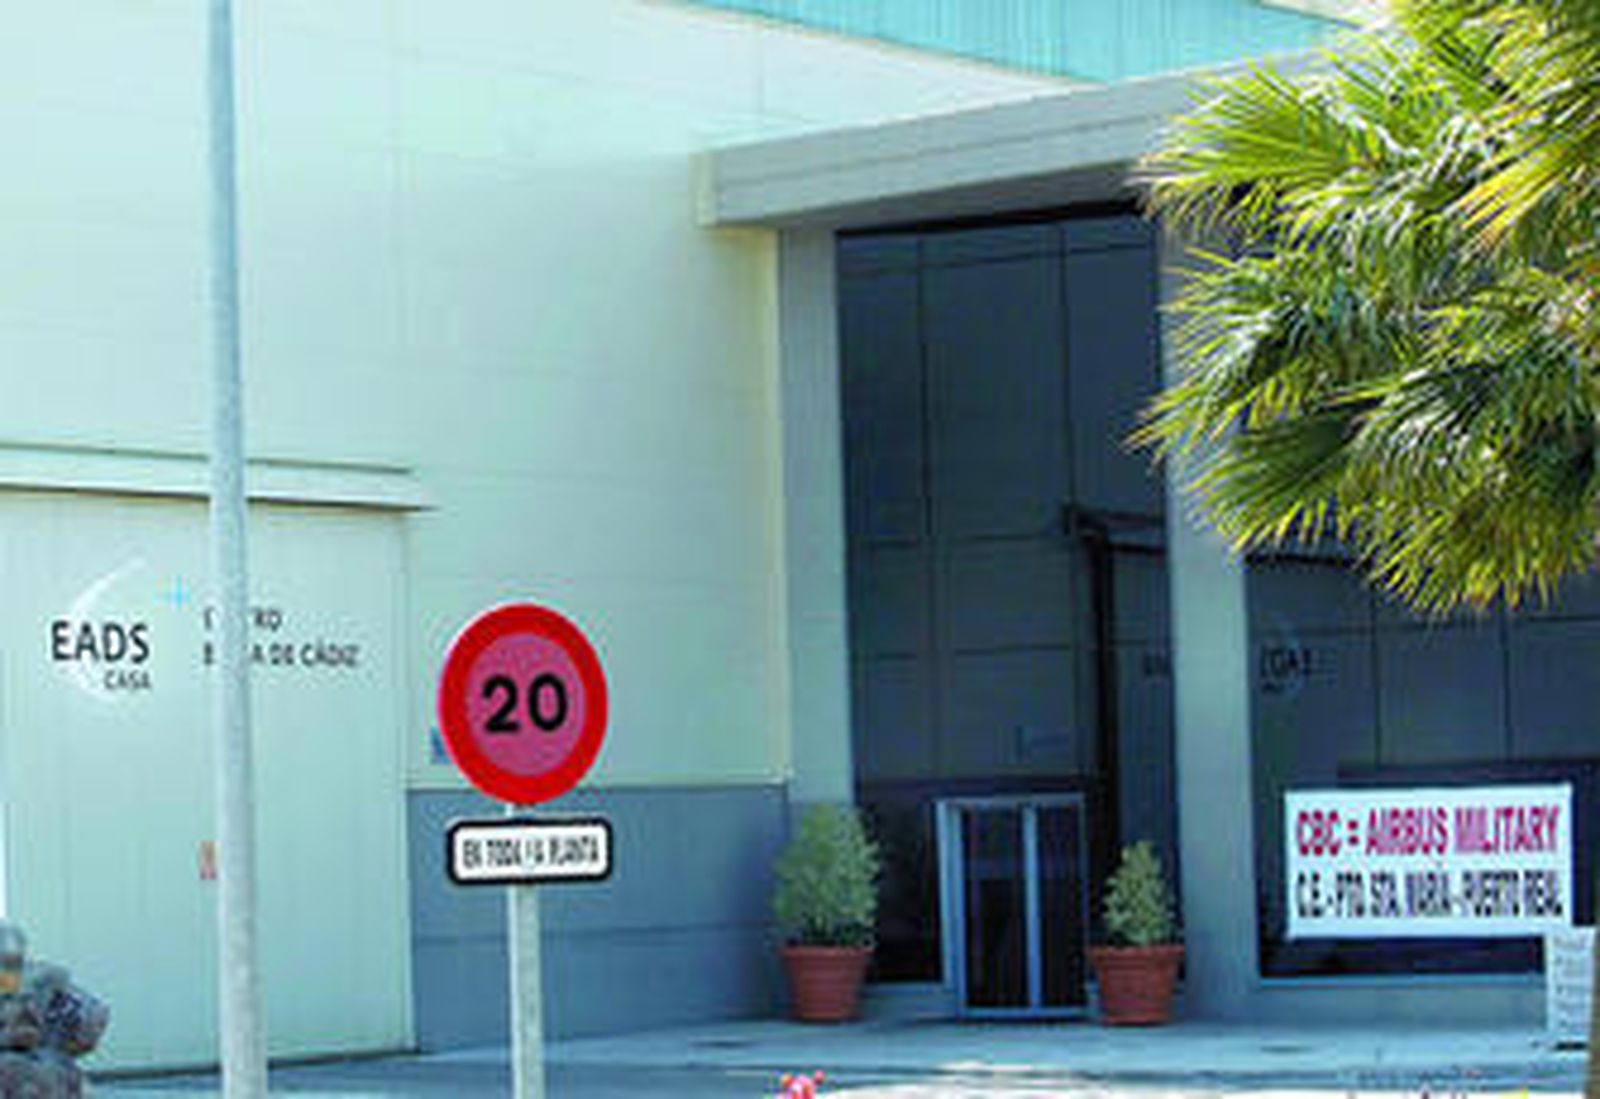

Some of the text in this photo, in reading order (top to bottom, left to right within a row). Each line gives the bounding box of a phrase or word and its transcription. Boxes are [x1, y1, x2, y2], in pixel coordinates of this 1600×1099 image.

[51, 620, 150, 664] EADS
[104, 669, 151, 690] CASA
[482, 672, 568, 732] 20
[1296, 810, 1341, 857] CBC
[1365, 806, 1448, 856] AIRBUS
[1453, 803, 1560, 854] MILITARY
[1523, 870, 1562, 917] REAL
